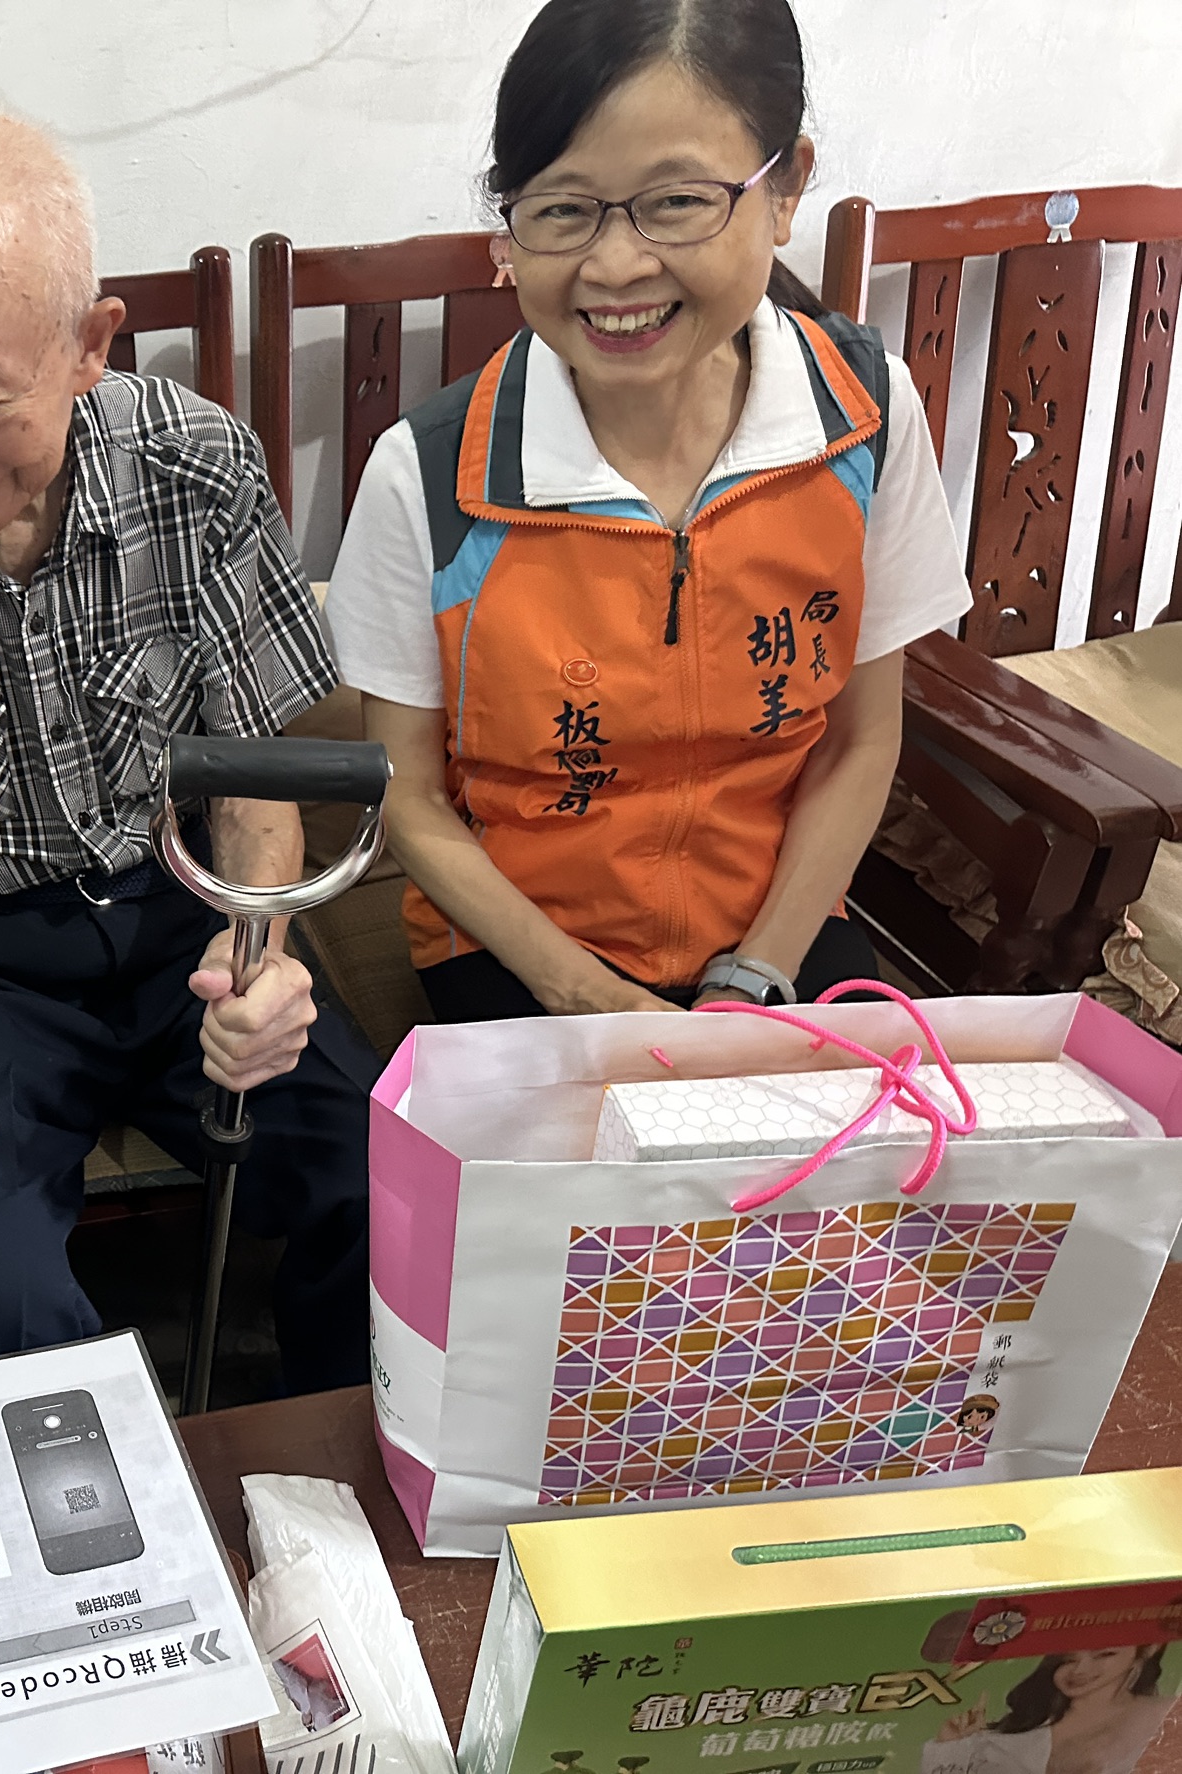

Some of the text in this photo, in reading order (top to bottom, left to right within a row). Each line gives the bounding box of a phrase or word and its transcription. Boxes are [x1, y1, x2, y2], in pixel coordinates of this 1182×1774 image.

[800, 590, 839, 682] 局長
[75, 1589, 142, 1617] 開啟相機
[87, 1615, 143, 1639] Step1
